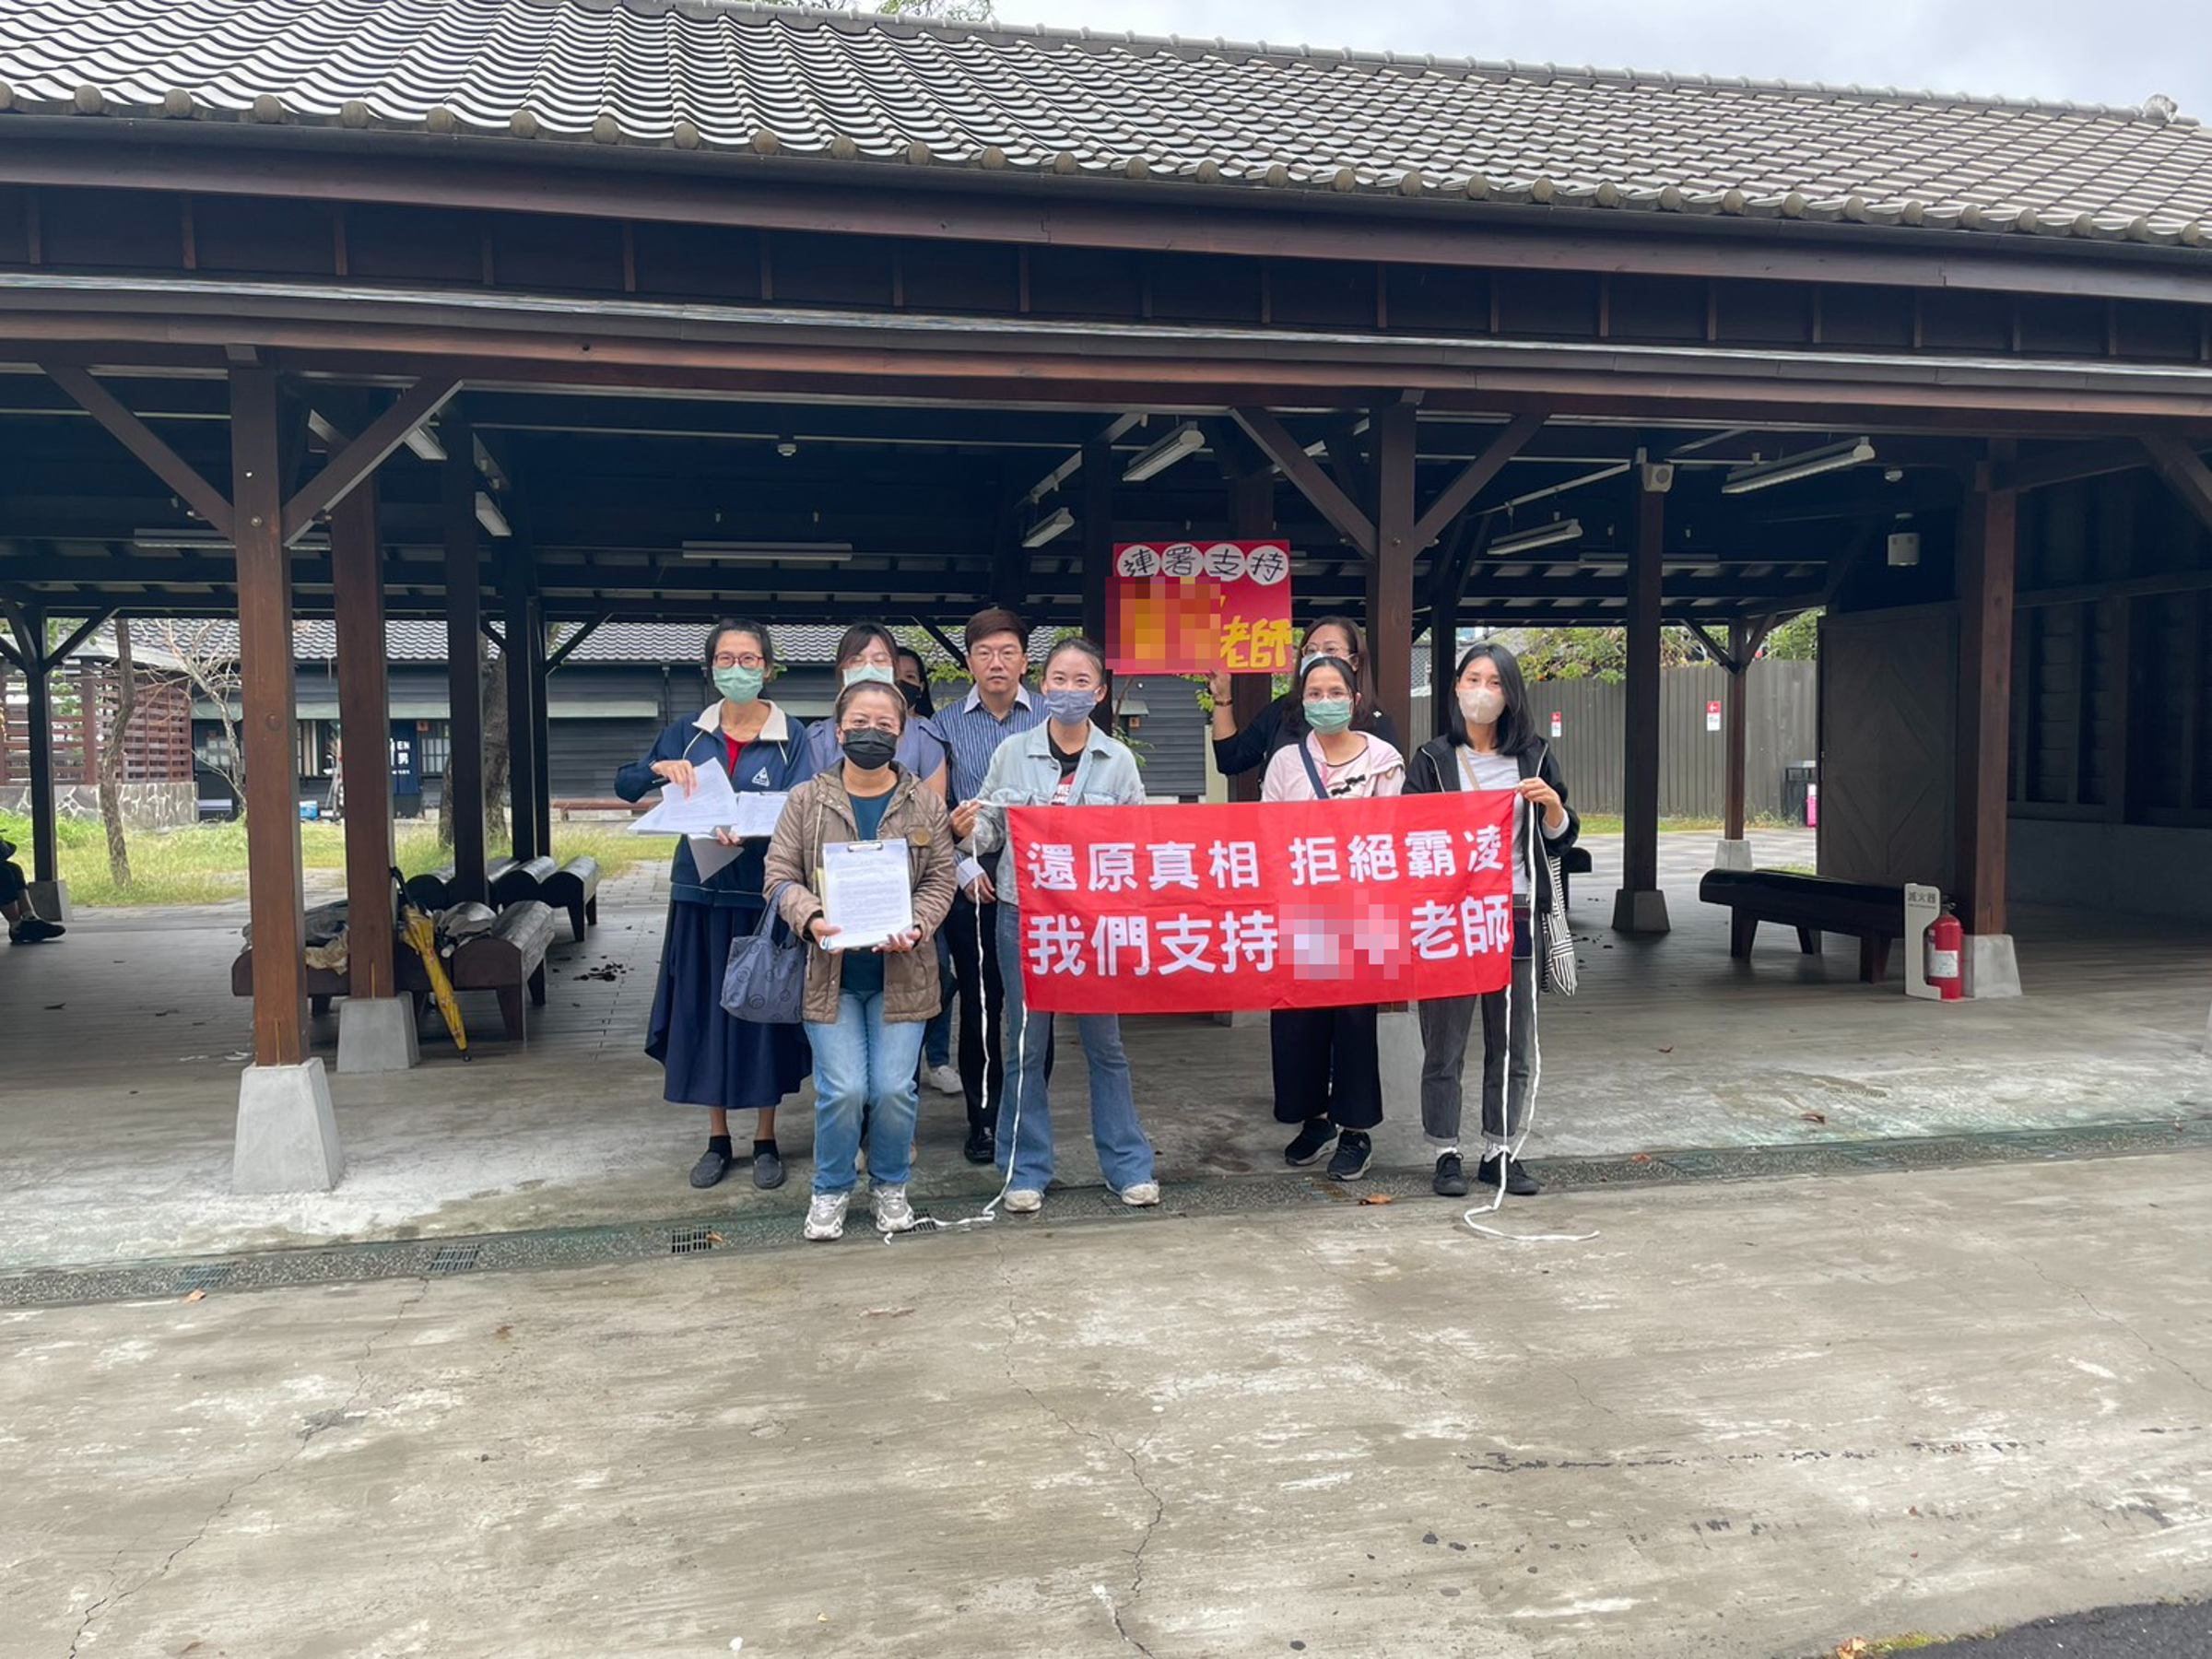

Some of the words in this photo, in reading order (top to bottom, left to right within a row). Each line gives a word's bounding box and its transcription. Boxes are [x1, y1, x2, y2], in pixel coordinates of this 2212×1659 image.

[1124, 546, 1284, 582] 連署支持
[1220, 615, 1292, 669] 老師
[1027, 840, 1260, 892] 還原真相
[1288, 824, 1504, 886] 拒絕霸凌
[1028, 910, 1278, 976] 我們支持
[1410, 894, 1510, 960] 老師
